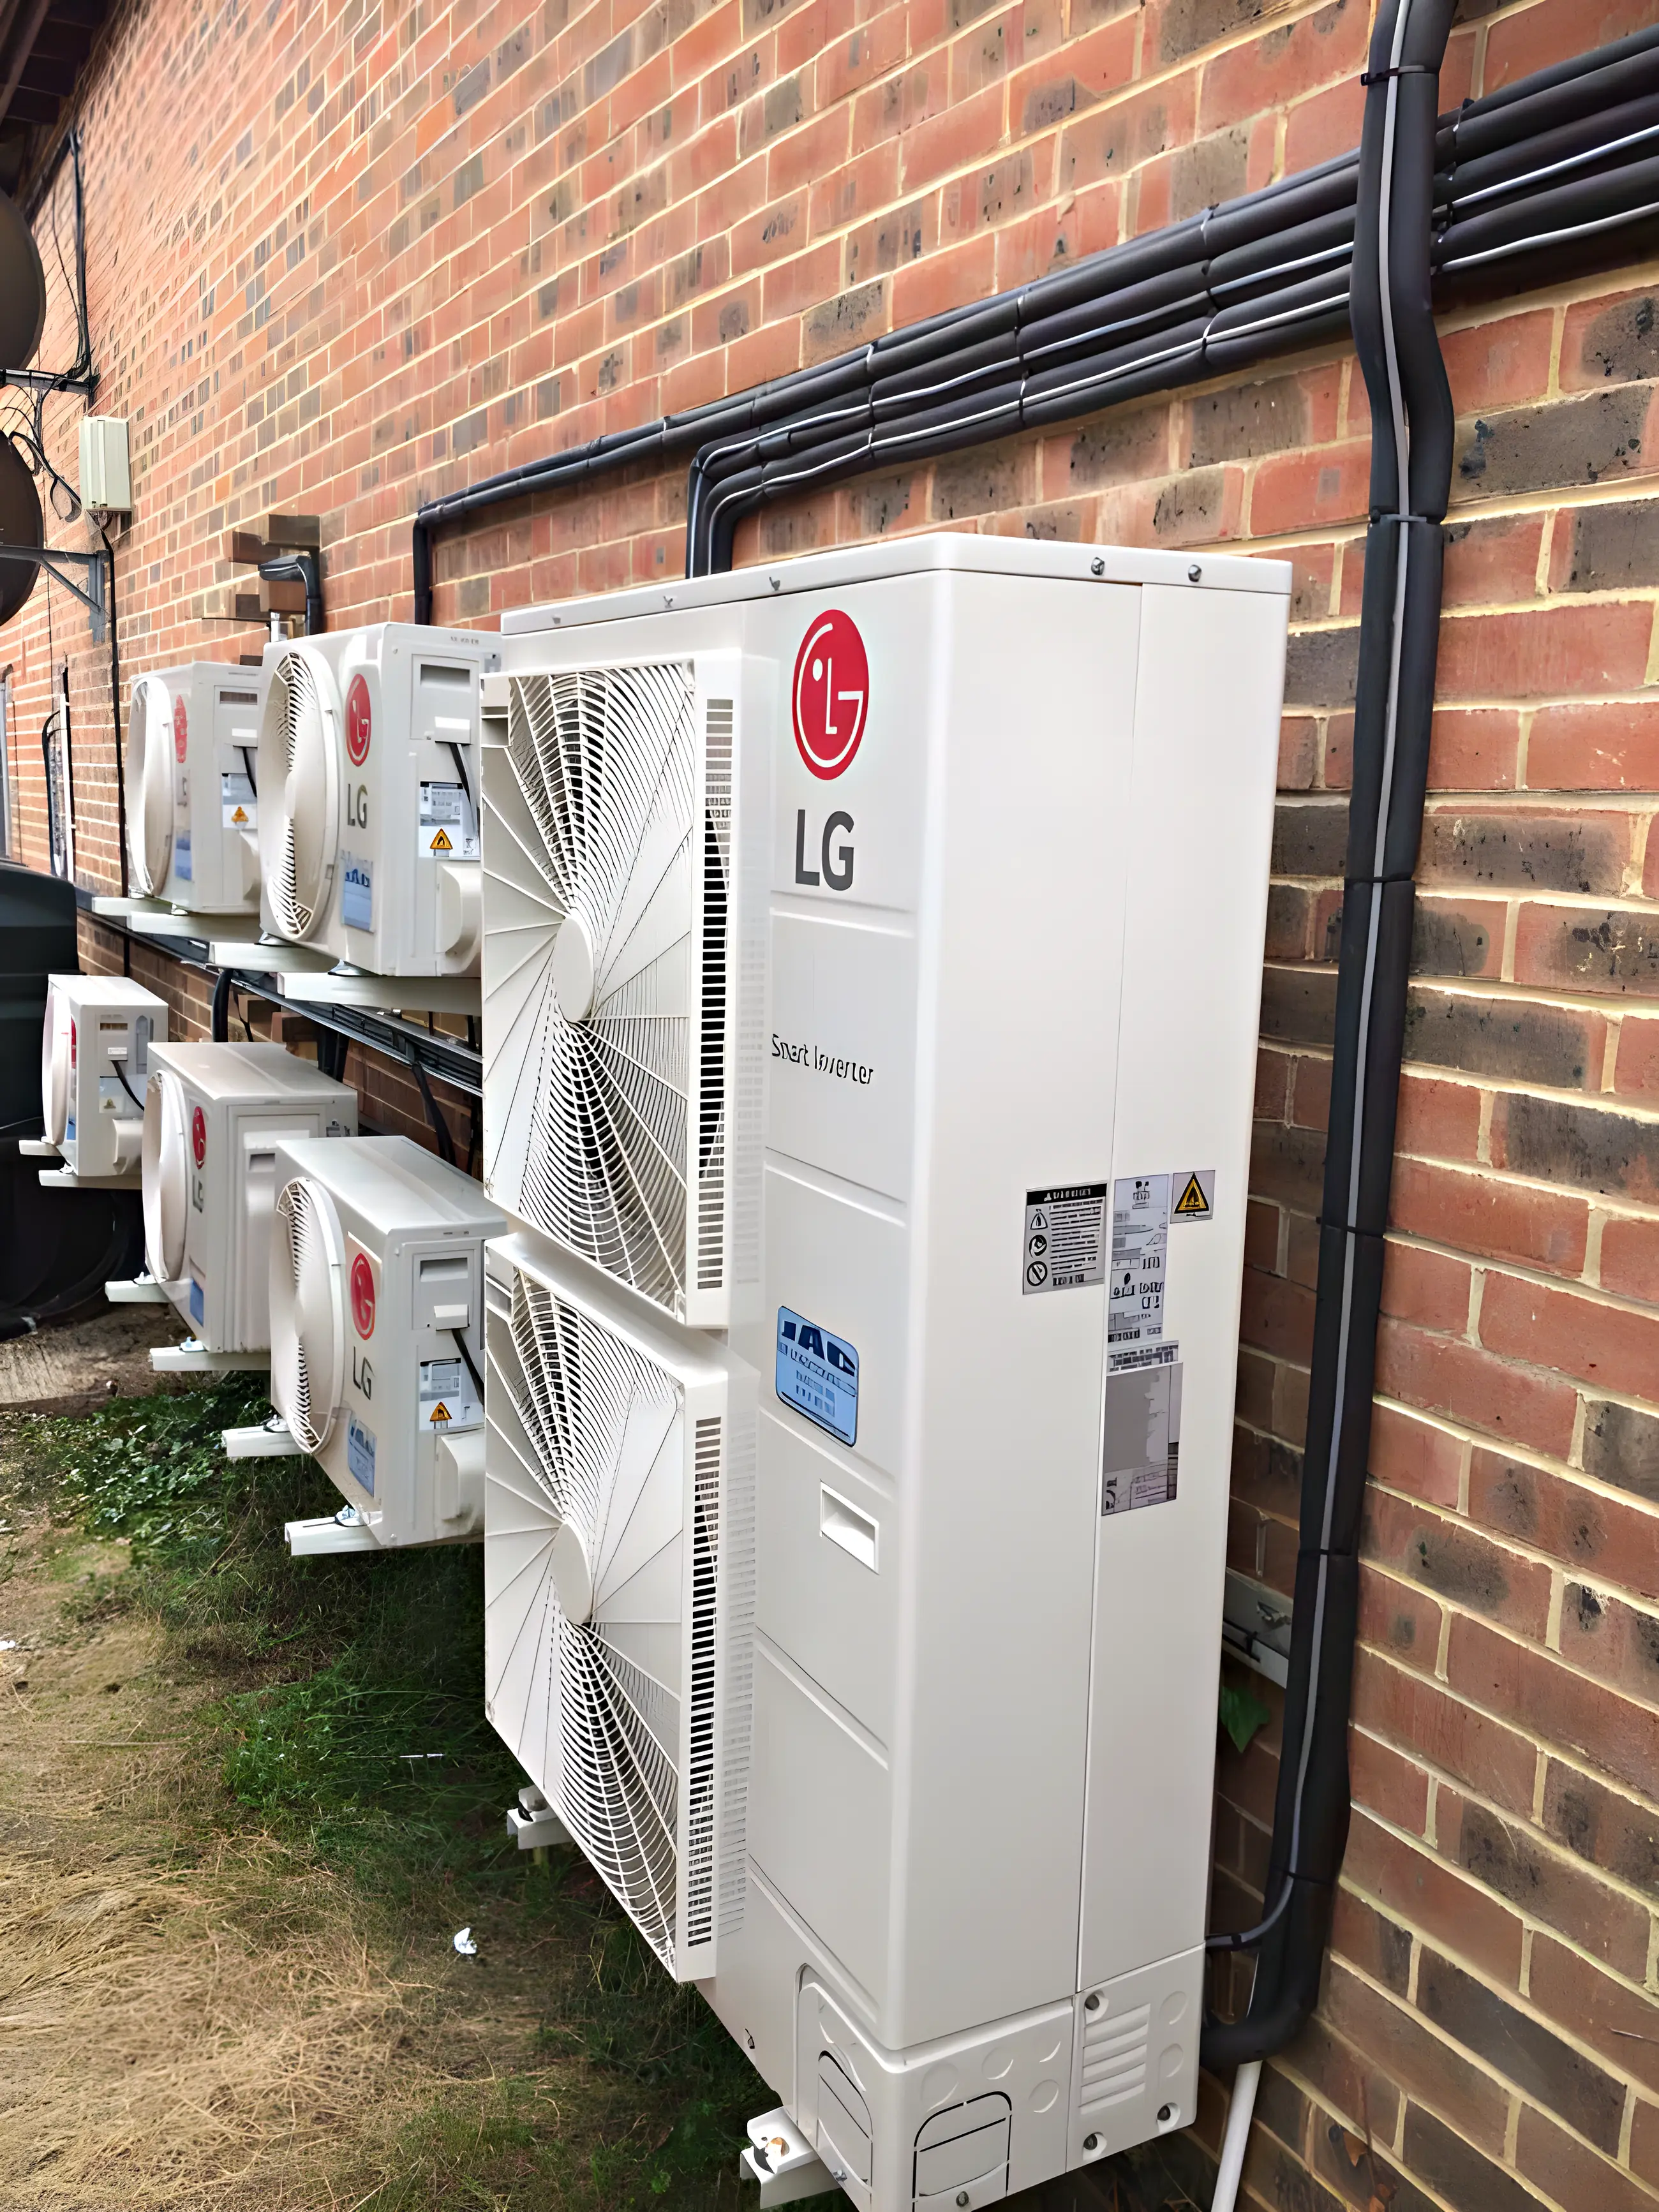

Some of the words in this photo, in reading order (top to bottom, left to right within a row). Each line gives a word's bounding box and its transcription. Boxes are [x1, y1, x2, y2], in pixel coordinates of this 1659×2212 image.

[347, 783, 368, 829] LG
[795, 809, 855, 891] LG
[353, 1346, 375, 1400] LG
